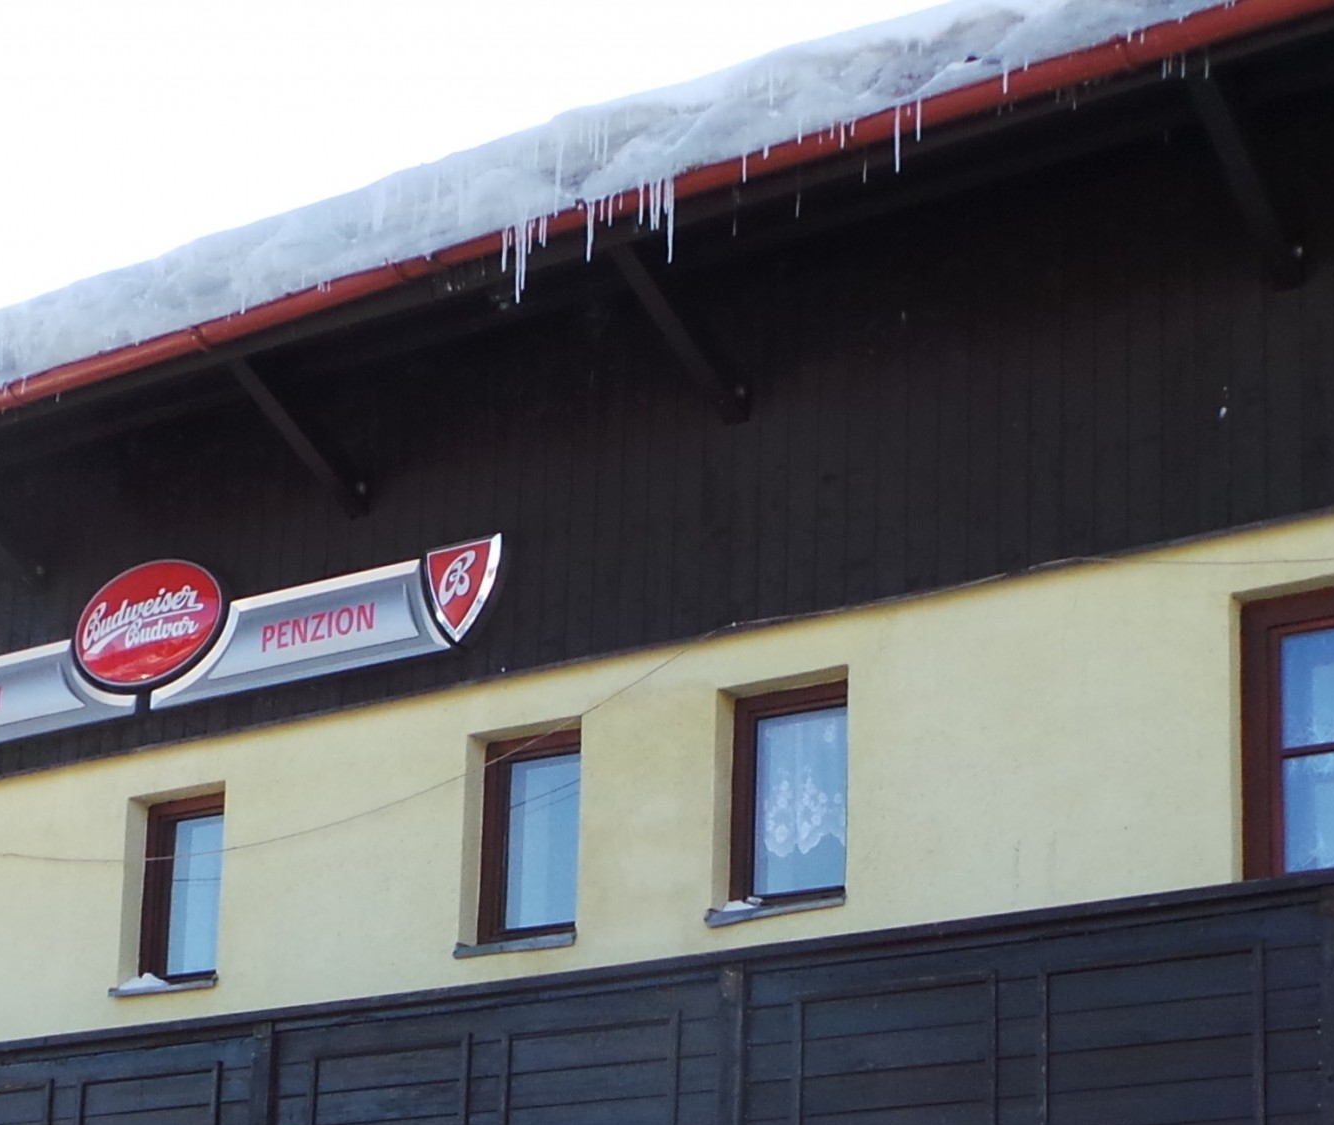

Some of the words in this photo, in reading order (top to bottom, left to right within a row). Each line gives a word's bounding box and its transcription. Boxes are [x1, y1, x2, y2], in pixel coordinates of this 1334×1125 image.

[82, 585, 204, 655] Budweiser
[125, 616, 199, 648] Budvar
[262, 602, 376, 651] PENZION
